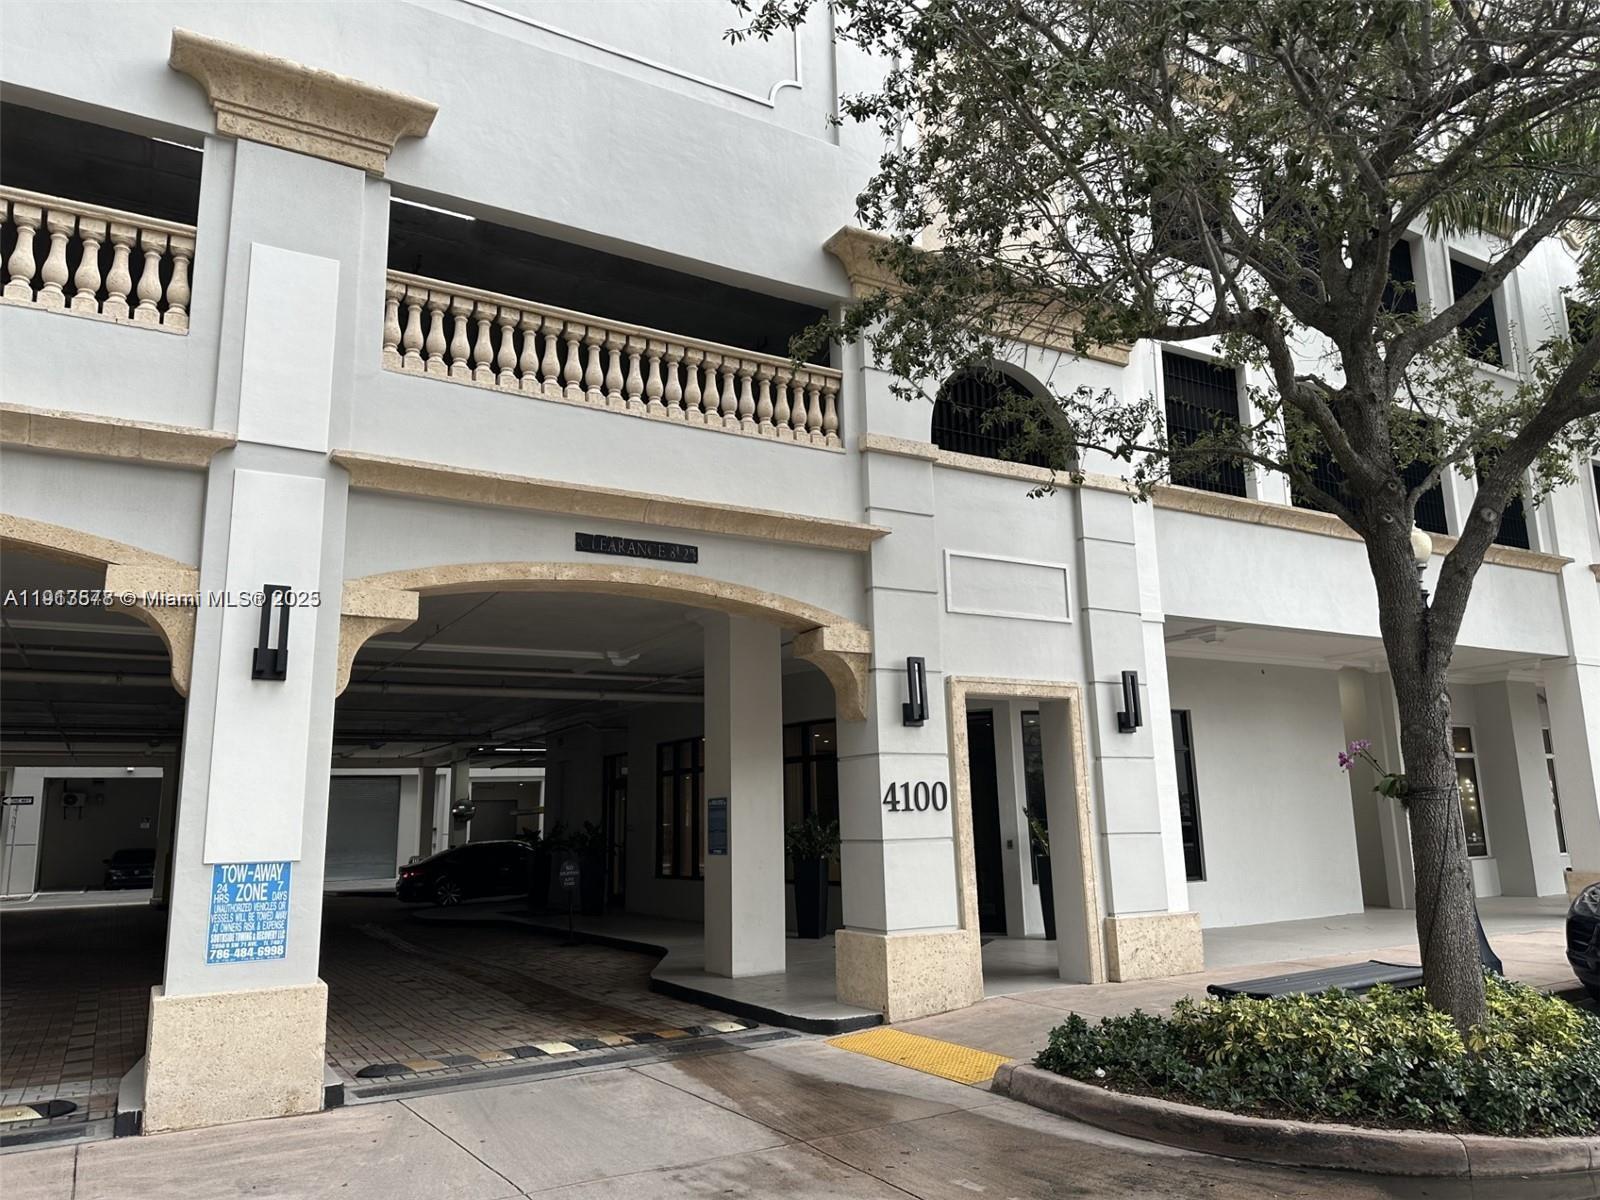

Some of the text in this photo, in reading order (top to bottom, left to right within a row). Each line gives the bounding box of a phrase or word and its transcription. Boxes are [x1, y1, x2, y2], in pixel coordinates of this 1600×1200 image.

[882, 781, 948, 812] 4100
[221, 863, 284, 884] TOW-AWAY
[216, 884, 228, 894] 24
[236, 883, 269, 902] ZONE
[277, 881, 285, 891] 7
[213, 895, 230, 905] HRS
[271, 891, 288, 901] DAYS
[214, 901, 287, 913] UNAUTHORIZED VEHICLES OR
[211, 910, 289, 923] VESSELS WILL BE TOWED AWAY
[219, 922, 242, 932] OWNERS
[243, 921, 255, 931] RISK
[262, 919, 285, 930] EXPENSE
[209, 945, 284, 960] 786-484-6998
